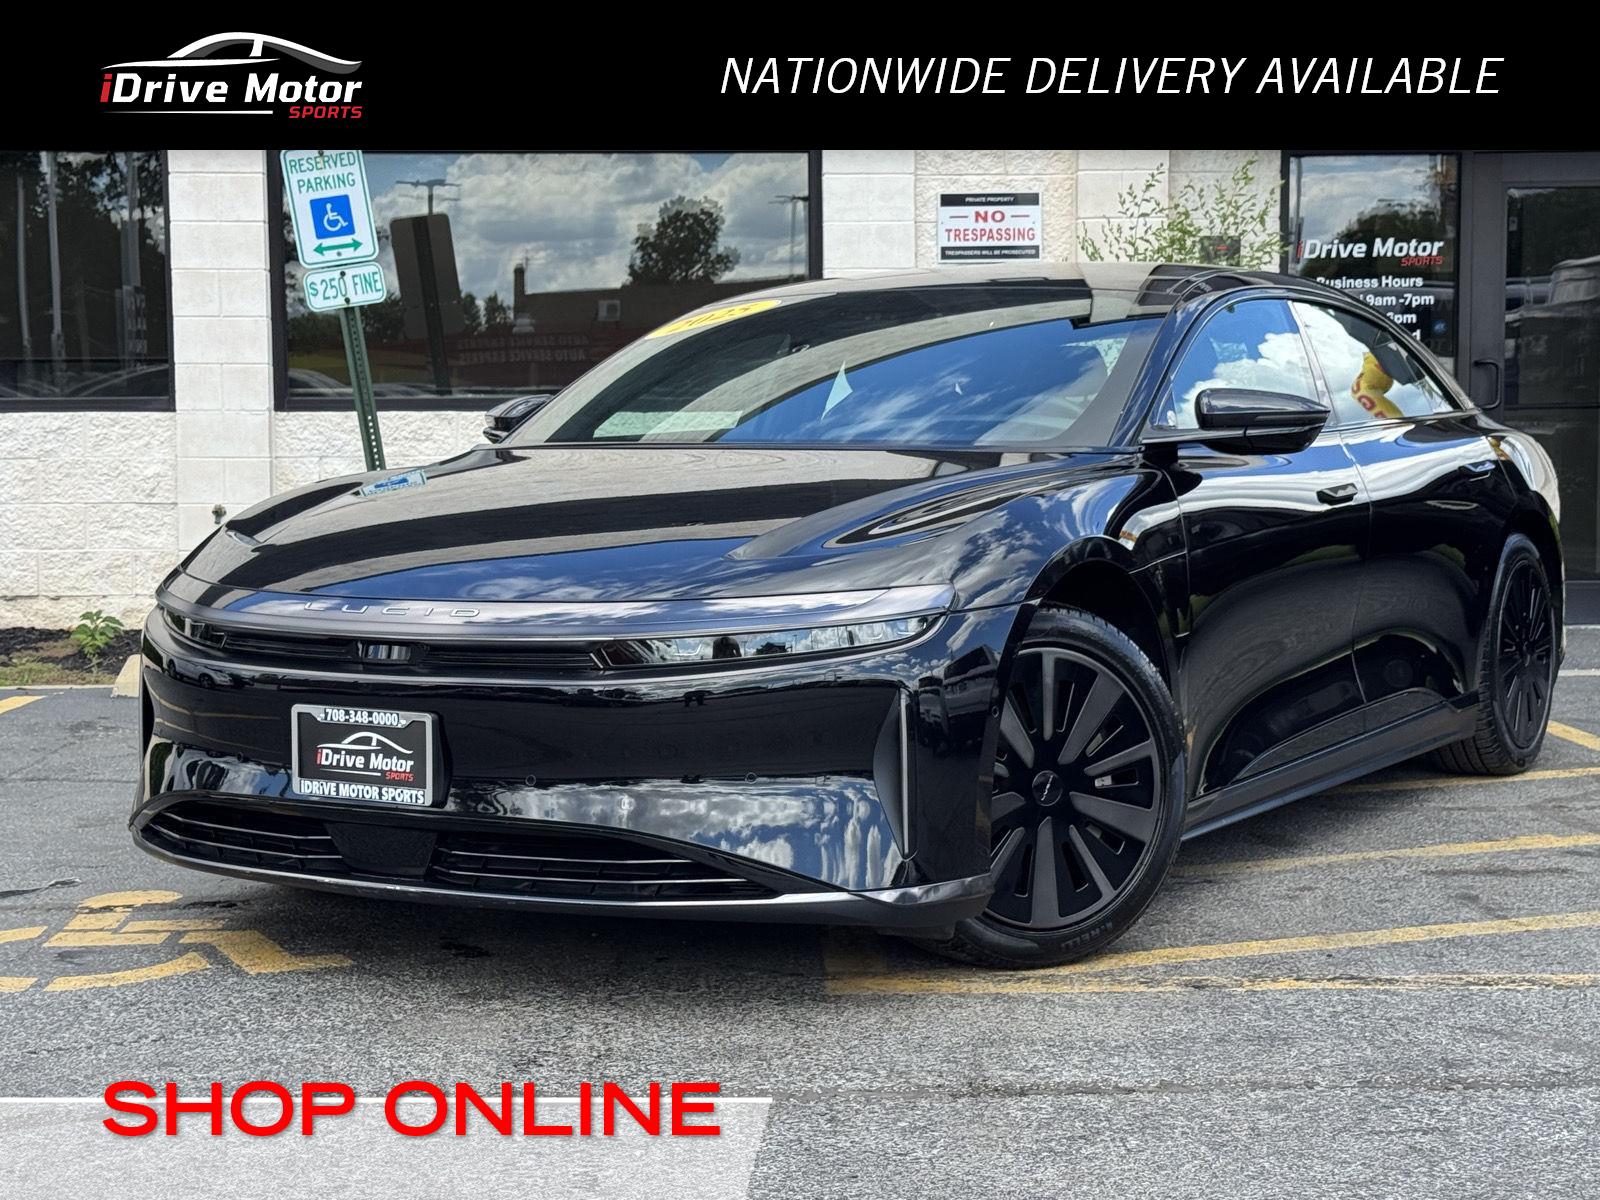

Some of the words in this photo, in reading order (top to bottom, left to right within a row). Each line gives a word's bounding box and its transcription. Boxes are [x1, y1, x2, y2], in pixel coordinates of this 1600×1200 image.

[288, 151, 356, 175] RESERVED
[297, 172, 356, 194] PARKING
[974, 210, 1006, 224] NO
[945, 227, 1035, 242] TRESPASSING
[1296, 239, 1368, 259] iDrive
[1372, 237, 1445, 257] Motor
[1400, 256, 1444, 267] SPORTS
[352, 271, 382, 296] FINE
[1381, 275, 1424, 289] Hours
[1366, 293, 1397, 306] 9am
[303, 601, 481, 618] LUCID
[325, 708, 399, 727] 708-348-0000
[316, 748, 366, 769] iDrive
[369, 752, 415, 774] Motor
[385, 771, 414, 782] SPORTS
[339, 782, 380, 800] MOTOR
[381, 786, 425, 805] SPORTS
